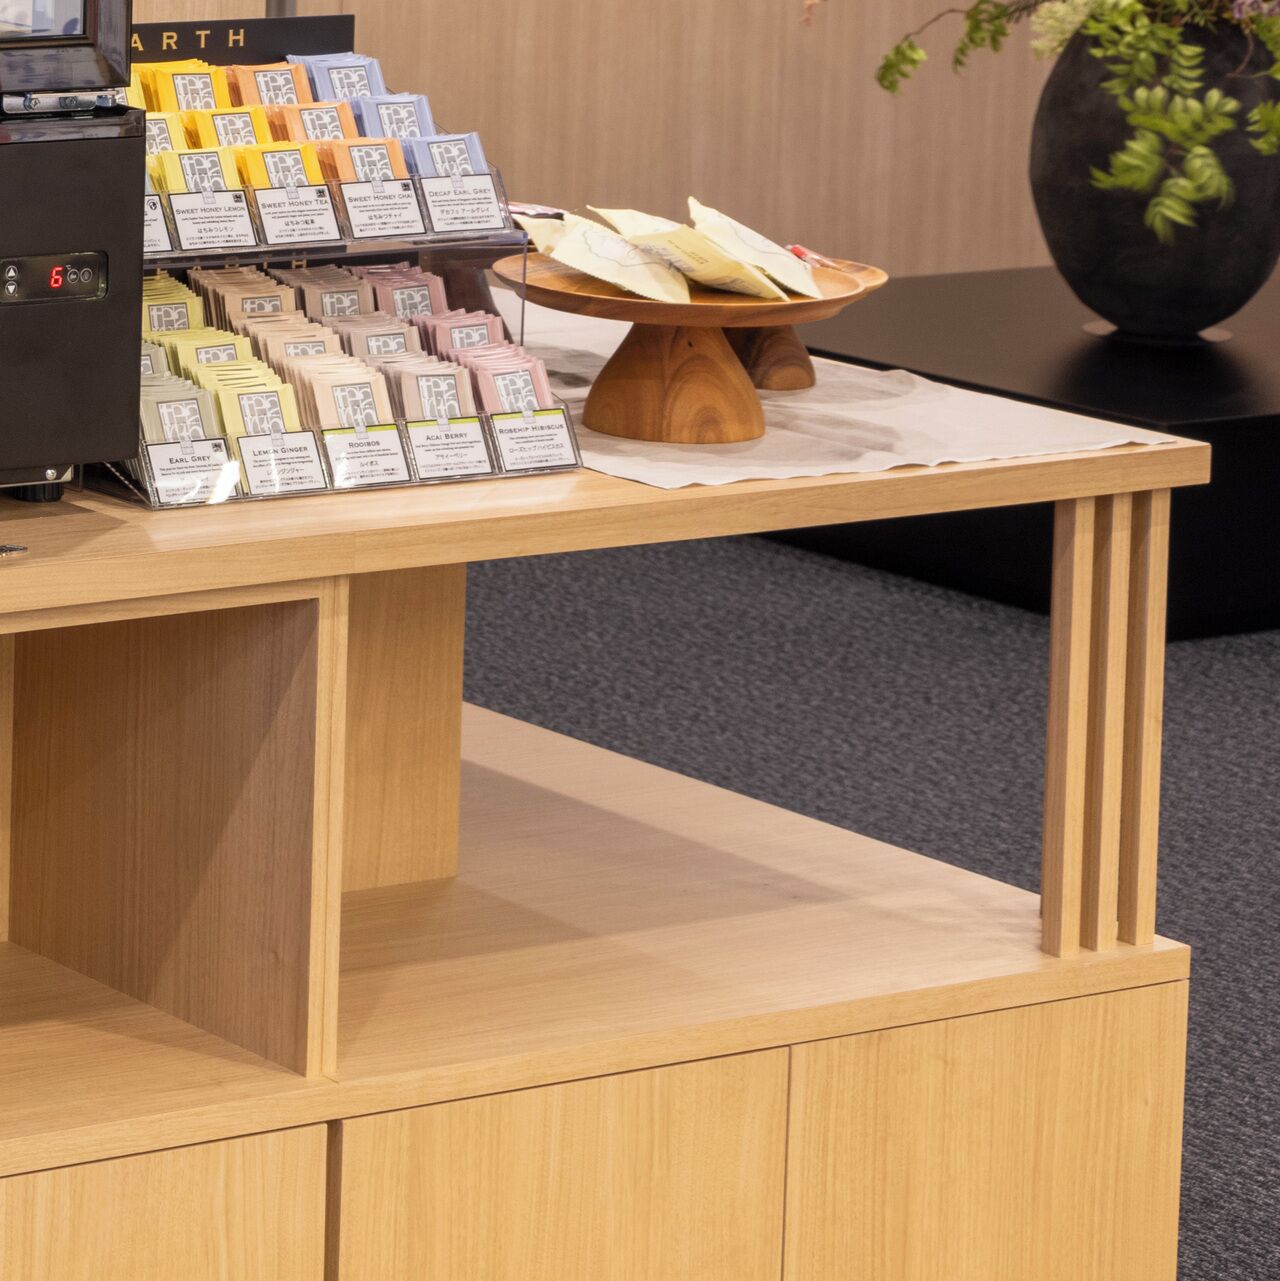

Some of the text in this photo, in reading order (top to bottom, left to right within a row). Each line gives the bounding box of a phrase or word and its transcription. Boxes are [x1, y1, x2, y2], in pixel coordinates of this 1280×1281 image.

[197, 226, 234, 234] はちみつレモン
[50, 265, 64, 289] 6
